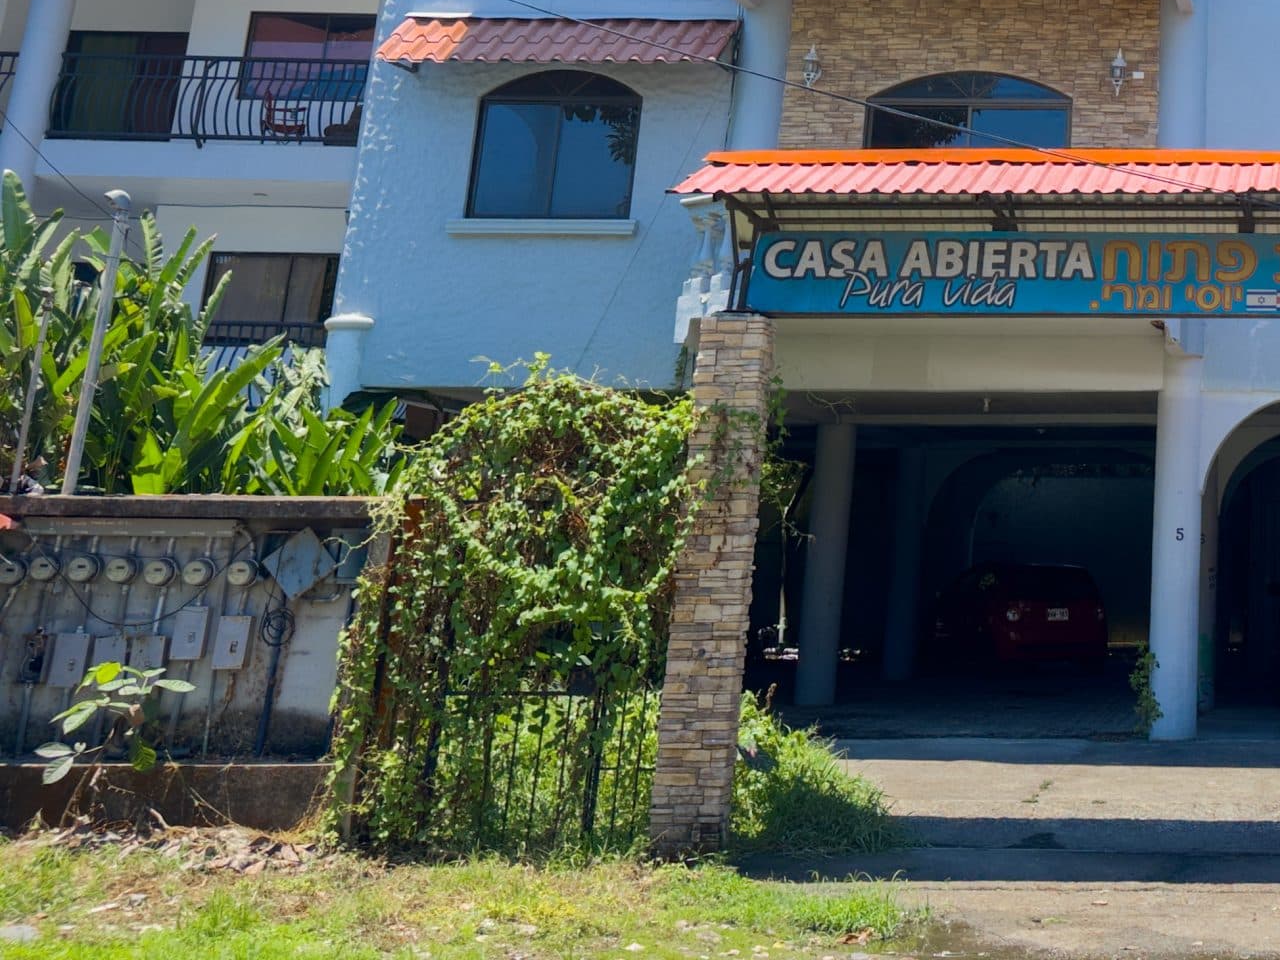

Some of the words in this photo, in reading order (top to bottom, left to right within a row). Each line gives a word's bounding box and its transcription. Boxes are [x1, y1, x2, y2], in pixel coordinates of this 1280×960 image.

[764, 240, 888, 279] CASA
[900, 240, 1095, 279] ABIERTA
[1102, 240, 1258, 283] פתוח
[841, 270, 924, 307] Pura
[943, 274, 1015, 307] vida
[1185, 284, 1243, 311] יוסי
[1175, 527, 1185, 542] 5
